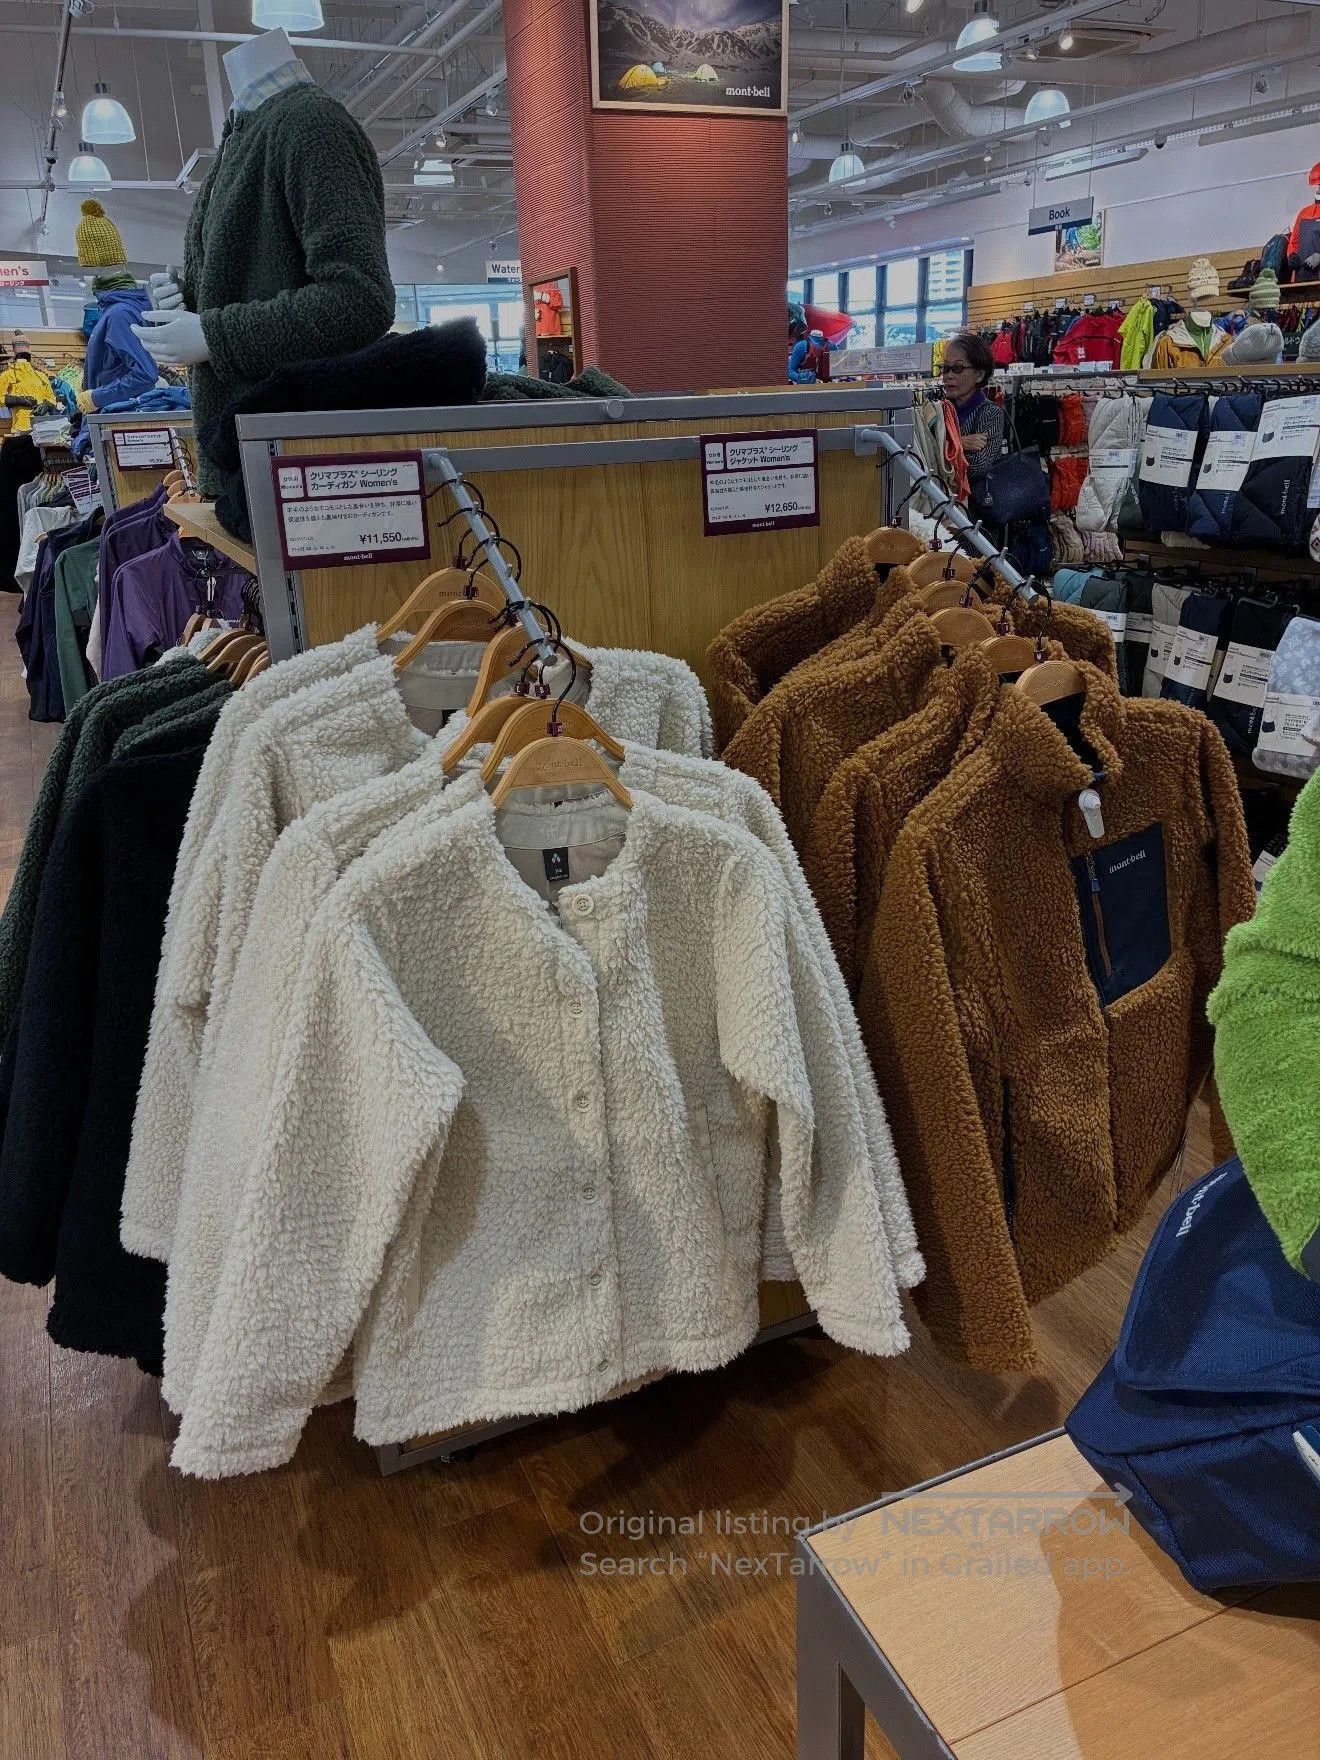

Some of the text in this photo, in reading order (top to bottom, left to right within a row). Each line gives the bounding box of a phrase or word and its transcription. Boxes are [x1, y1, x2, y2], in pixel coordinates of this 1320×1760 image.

[1049, 206, 1071, 220] Book
[491, 264, 521, 274] Water
[760, 454, 791, 463] Women's
[361, 467, 398, 478] シーリング
[311, 478, 399, 491] カーディガン Women's
[765, 501, 798, 514] ¥12,650
[359, 531, 402, 545] ¥11,550
